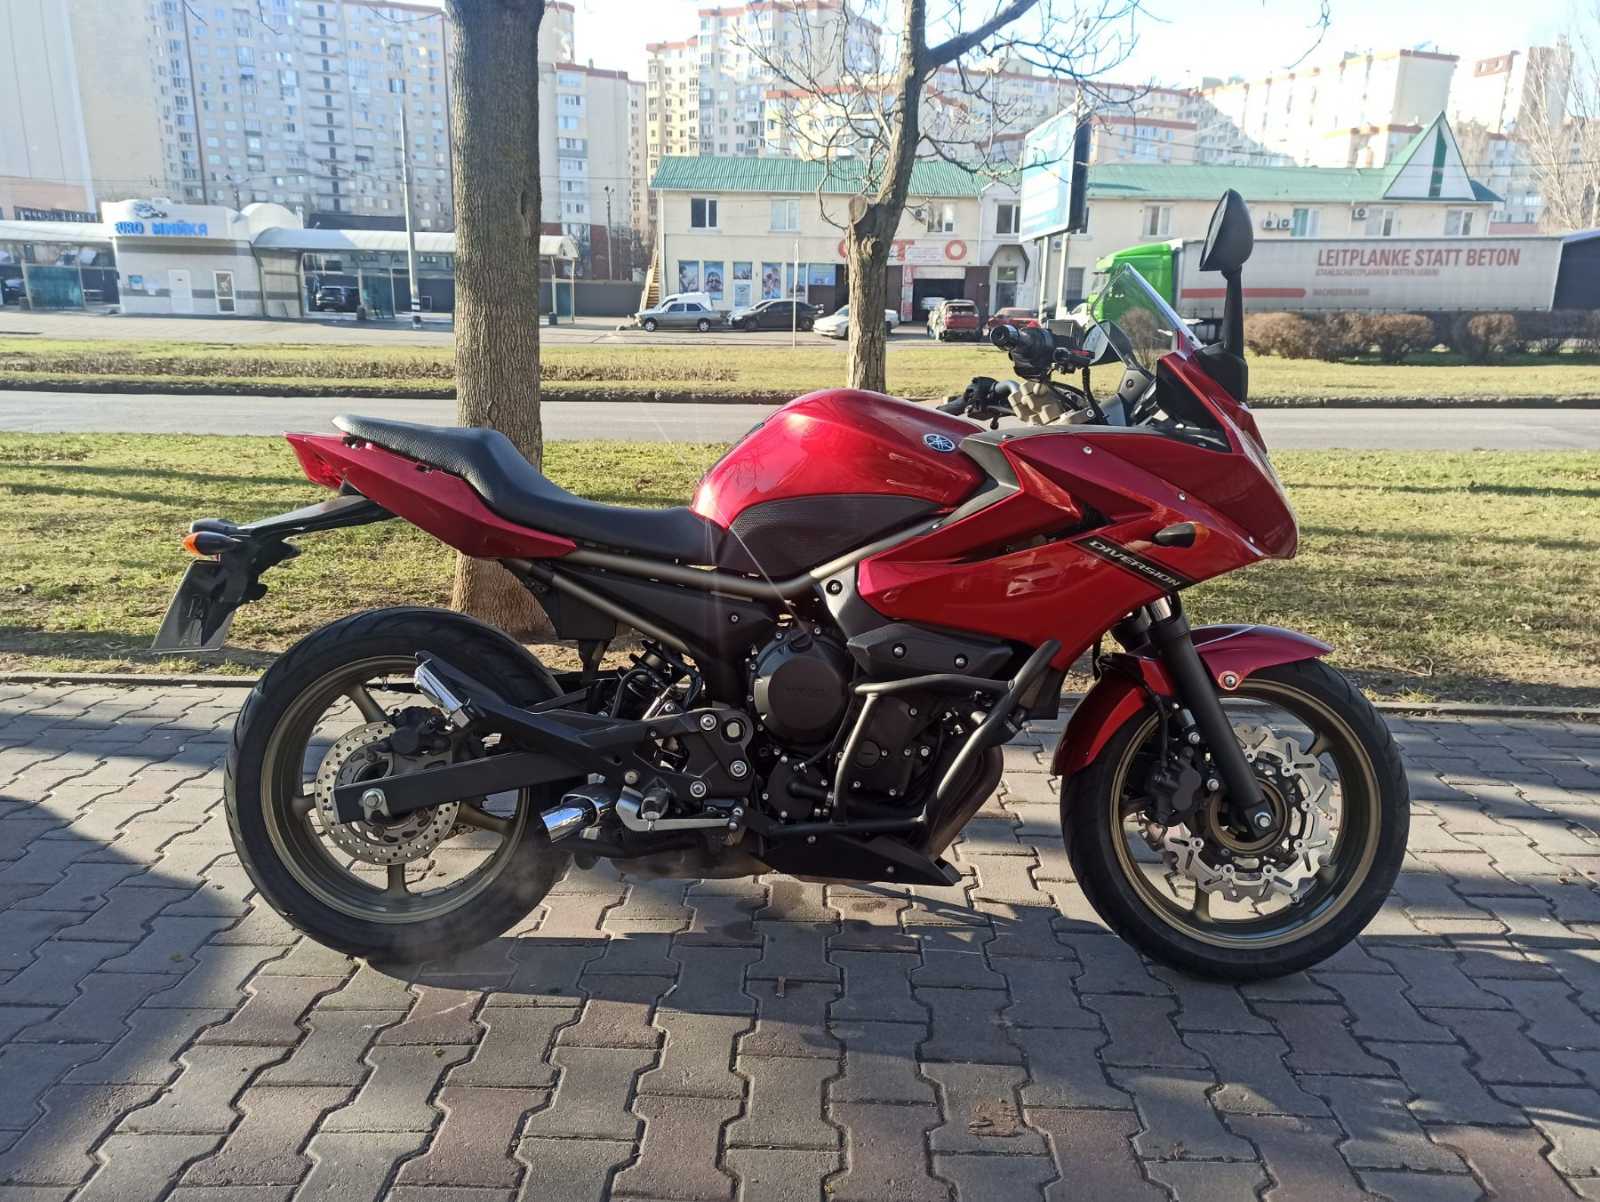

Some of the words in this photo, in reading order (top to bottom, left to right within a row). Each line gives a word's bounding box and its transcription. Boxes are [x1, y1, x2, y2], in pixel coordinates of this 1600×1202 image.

[1317, 248, 1411, 267] LEITPLANKE
[1414, 248, 1463, 267] STATT
[1466, 247, 1521, 267] BETON
[1088, 539, 1181, 587] DIVERSION
